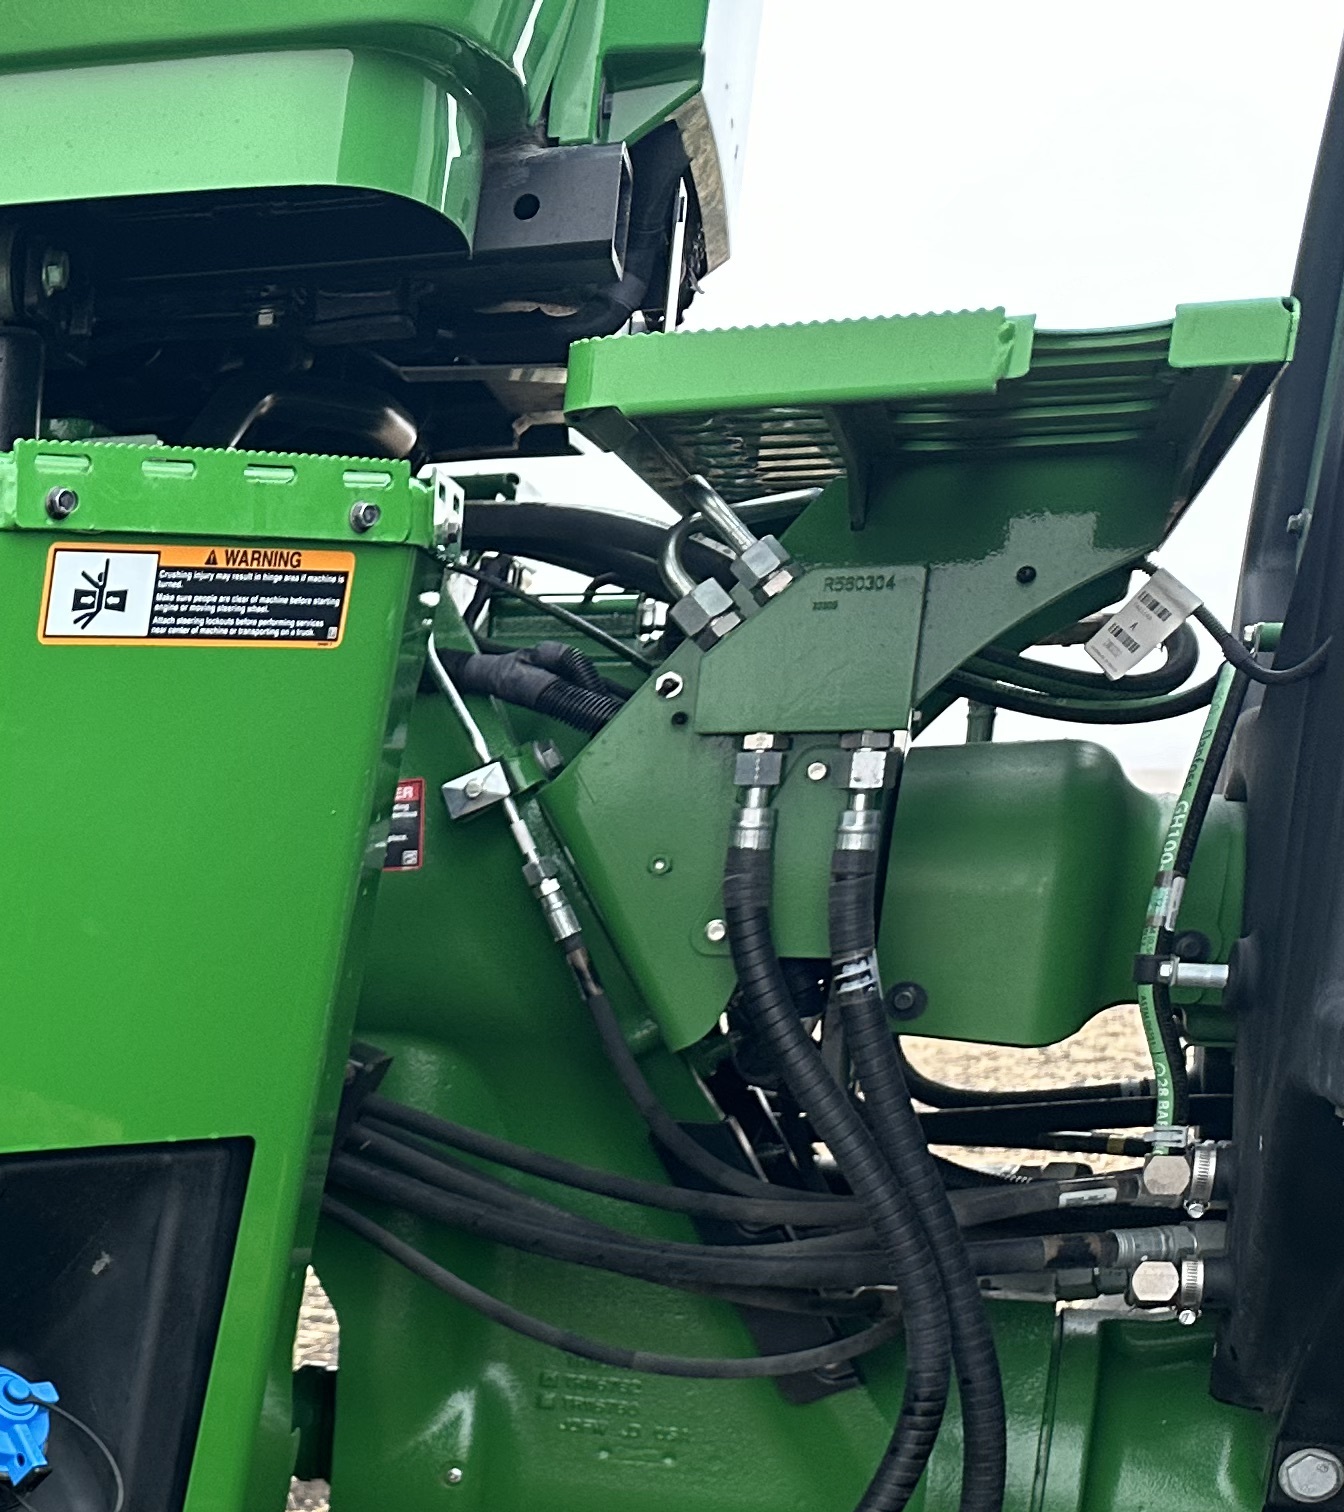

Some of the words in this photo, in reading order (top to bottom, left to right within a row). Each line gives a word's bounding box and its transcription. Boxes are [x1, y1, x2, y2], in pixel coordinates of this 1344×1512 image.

[224, 549, 302, 569] WARNING
[160, 570, 192, 581] Crushing
[194, 571, 214, 582] injury
[216, 573, 230, 582] may
[262, 574, 282, 583] hinge
[307, 575, 336, 583] machine
[158, 580, 182, 588] turned.
[156, 593, 174, 601] Make
[193, 595, 217, 603] people
[232, 595, 249, 603] clear
[259, 596, 288, 604] machine
[313, 598, 340, 607] starting
[155, 604, 178, 612] engine
[190, 604, 216, 614] moving
[217, 605, 245, 614] steering
[153, 616, 175, 624] Attach
[177, 617, 204, 626] steering
[258, 618, 295, 628] performing
[1129, 621, 1139, 632] A
[1185, 729, 1213, 788] Danfoss
[1158, 1080, 1170, 1097] 28
